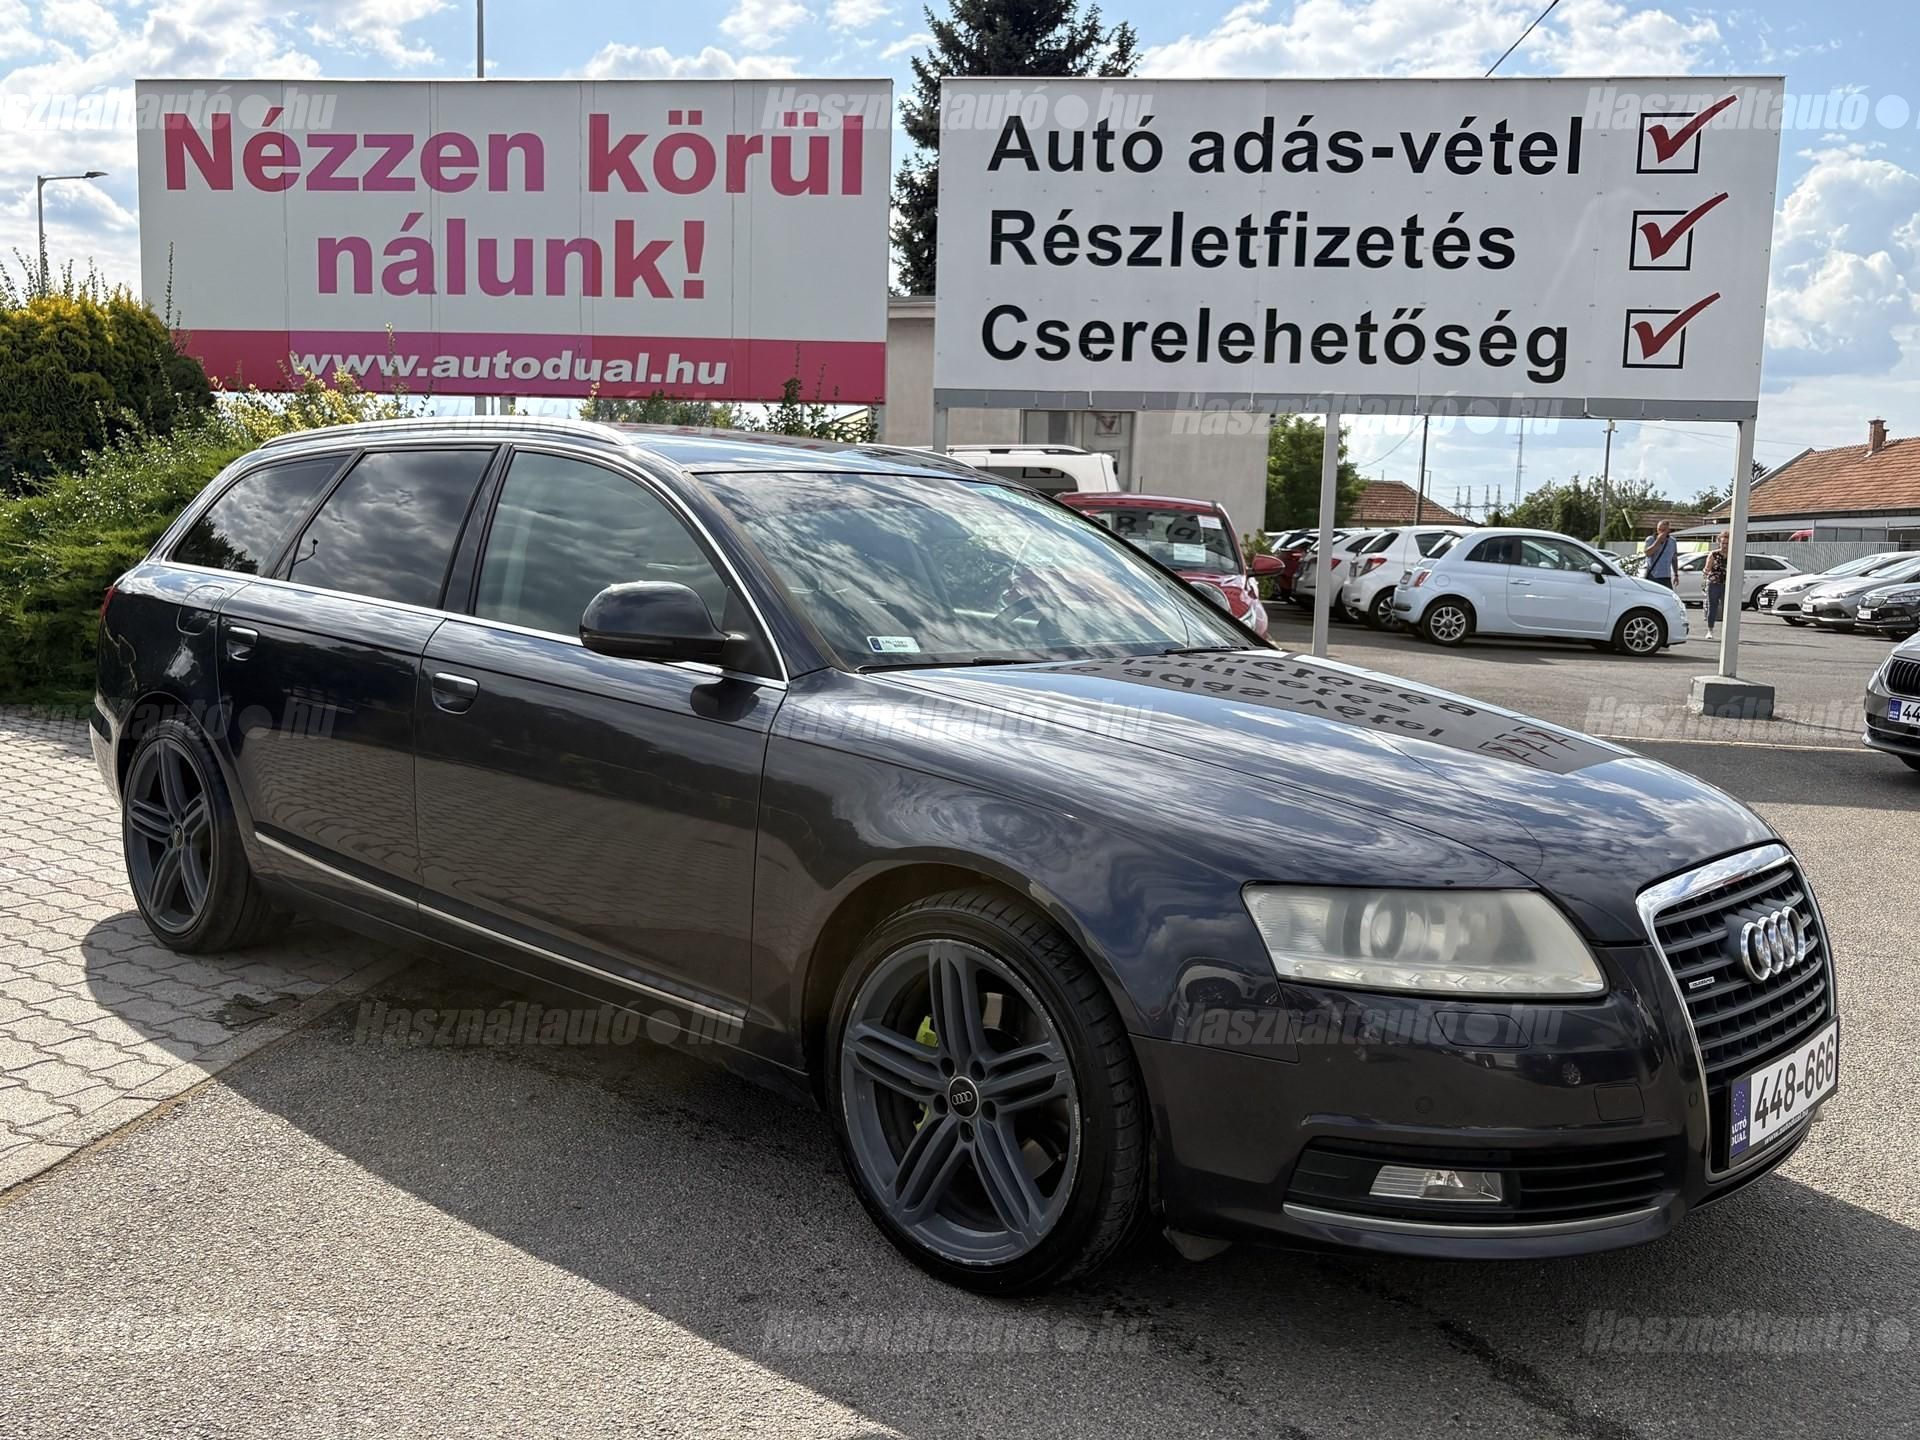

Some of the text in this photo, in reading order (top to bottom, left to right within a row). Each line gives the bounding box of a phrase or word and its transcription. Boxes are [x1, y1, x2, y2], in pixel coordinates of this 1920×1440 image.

[163, 107, 865, 196] Nézzen körül
[987, 115, 1584, 176] Autó adás-vétel
[317, 212, 706, 300] nálunk!
[990, 208, 1517, 270] Részletfizetés
[288, 349, 729, 386] www.autodual.hu
[981, 303, 1569, 385] Cserelehetőség
[1754, 1033, 1834, 1129] 448-666
